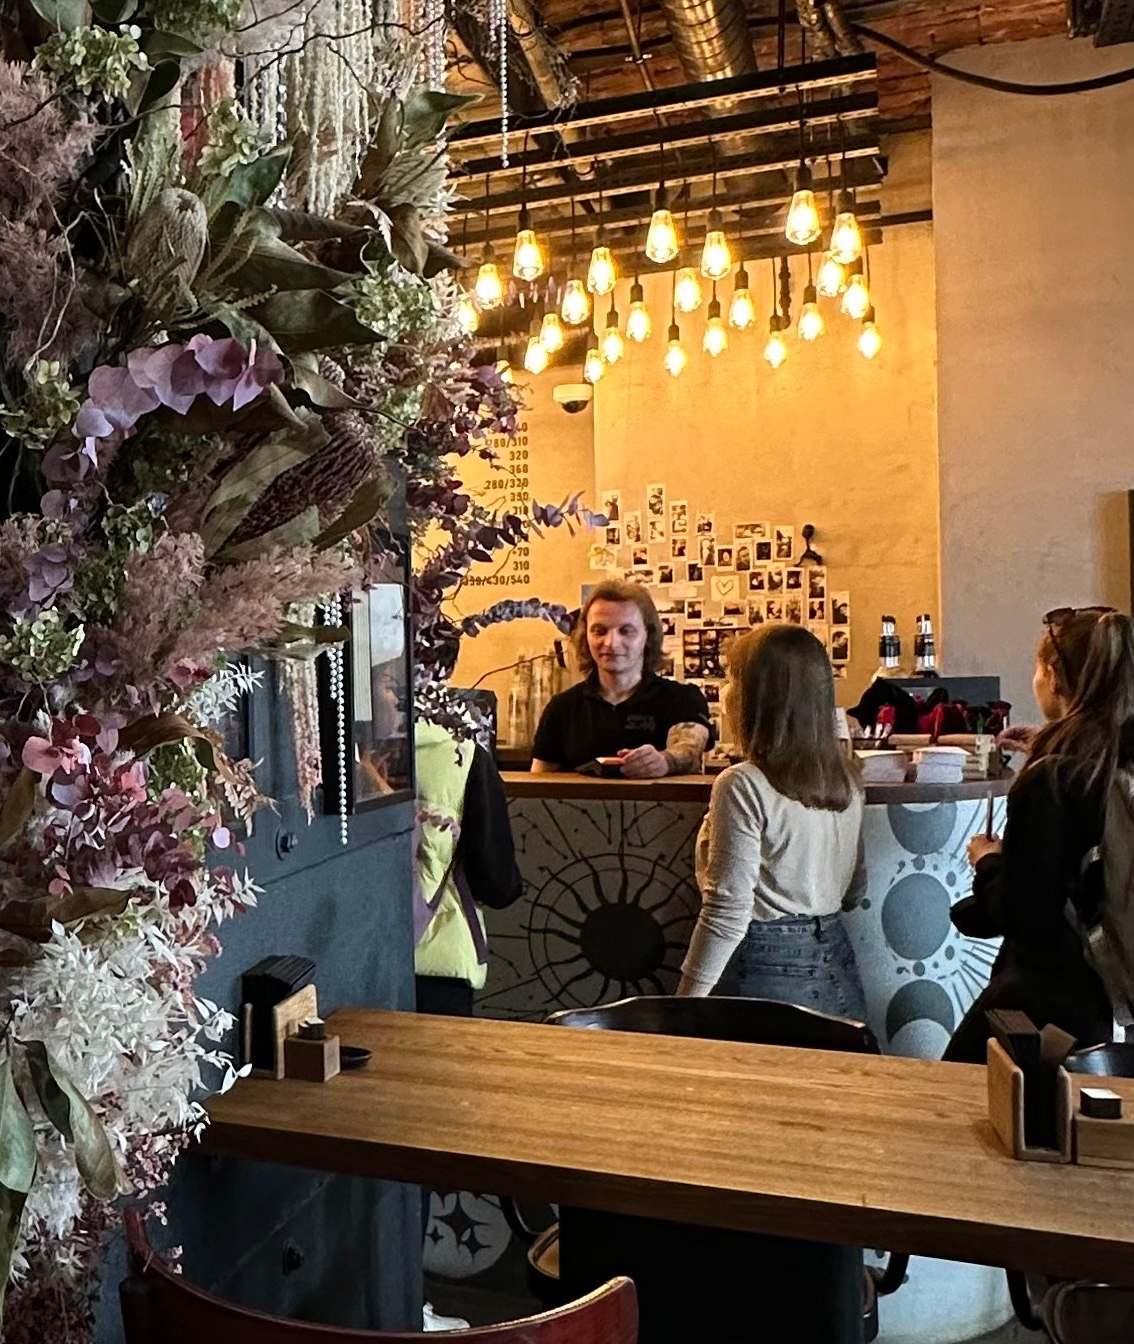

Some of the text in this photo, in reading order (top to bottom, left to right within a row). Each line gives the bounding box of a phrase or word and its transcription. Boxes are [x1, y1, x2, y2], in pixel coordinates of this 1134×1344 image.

[509, 450, 529, 461] 320
[509, 464, 529, 474] 360
[513, 561, 530, 571] 310
